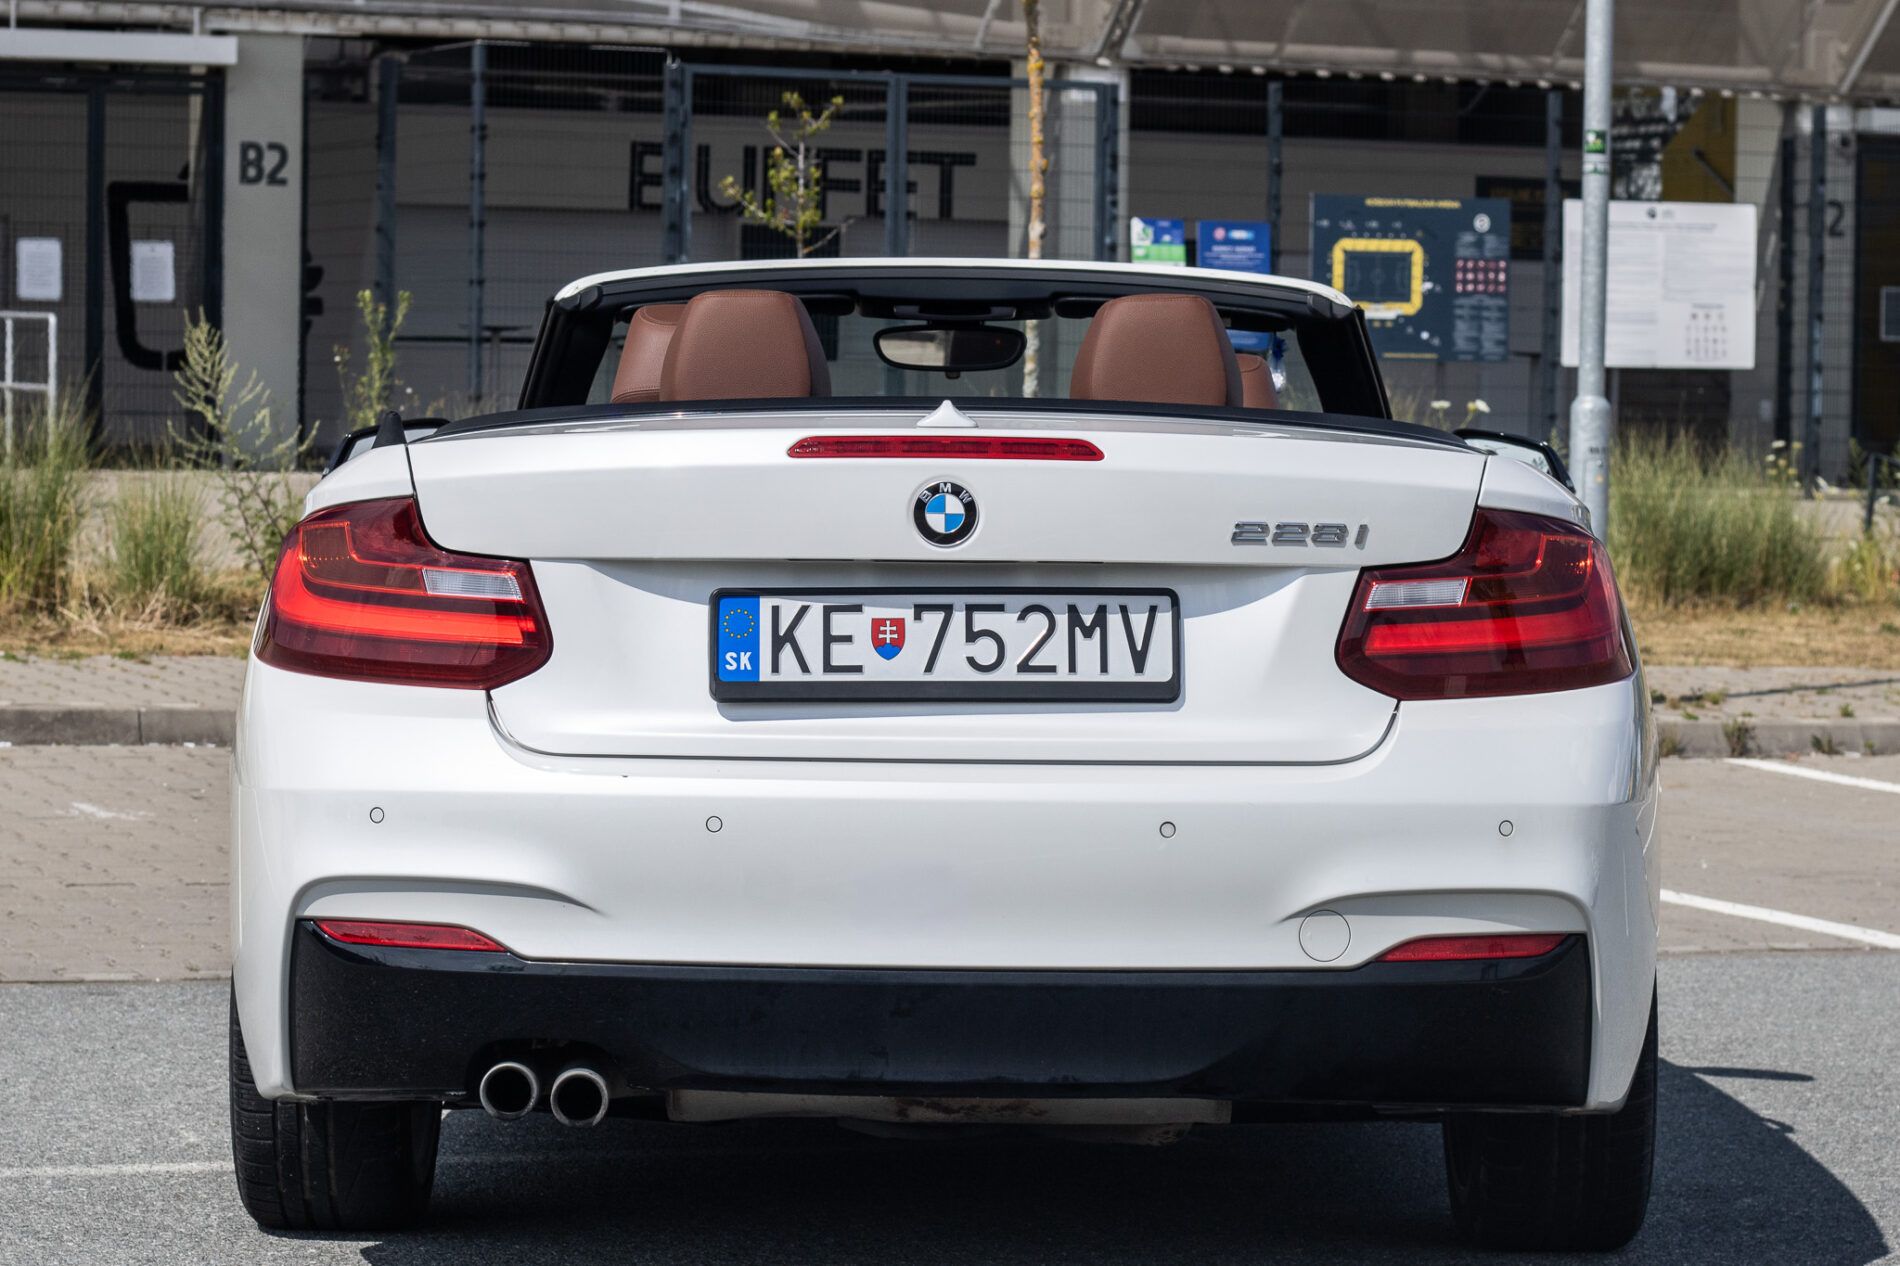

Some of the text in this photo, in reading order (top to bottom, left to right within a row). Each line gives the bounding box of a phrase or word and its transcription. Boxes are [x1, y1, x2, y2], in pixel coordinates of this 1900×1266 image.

[240, 141, 289, 186] B2
[919, 482, 972, 504] BMW
[771, 603, 1159, 674] KE 752MV
[725, 651, 752, 671] SK
